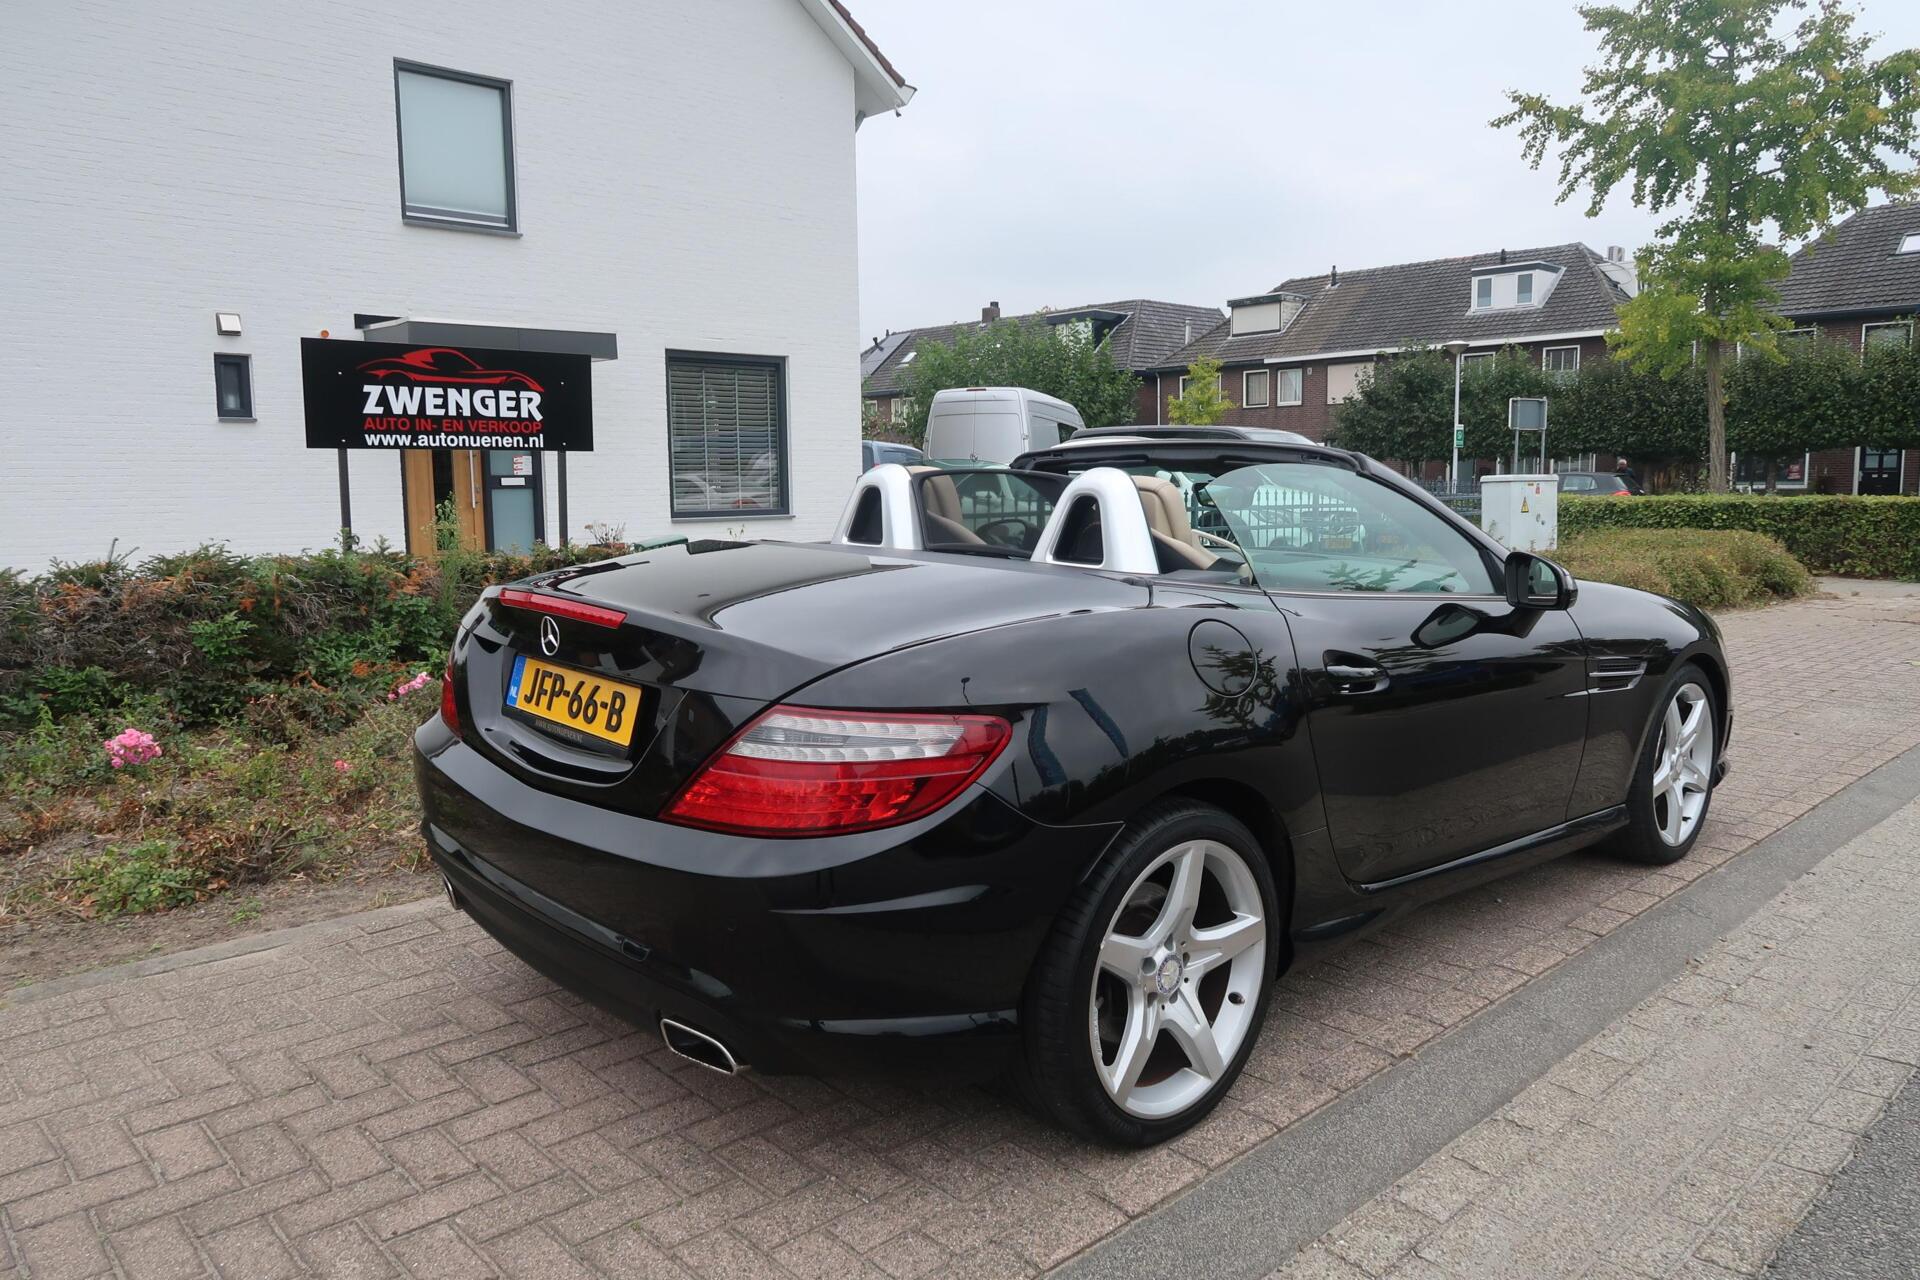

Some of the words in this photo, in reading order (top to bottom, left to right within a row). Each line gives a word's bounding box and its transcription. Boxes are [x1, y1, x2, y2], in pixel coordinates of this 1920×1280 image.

[362, 384, 544, 422] ZWENGER
[364, 417, 411, 431] AUTO
[415, 418, 438, 431] IN-
[442, 419, 464, 433] EN
[468, 420, 542, 434] VERKOOP
[364, 432, 544, 448] www.autonuenen.nl
[523, 667, 626, 733] JFP-66-B
